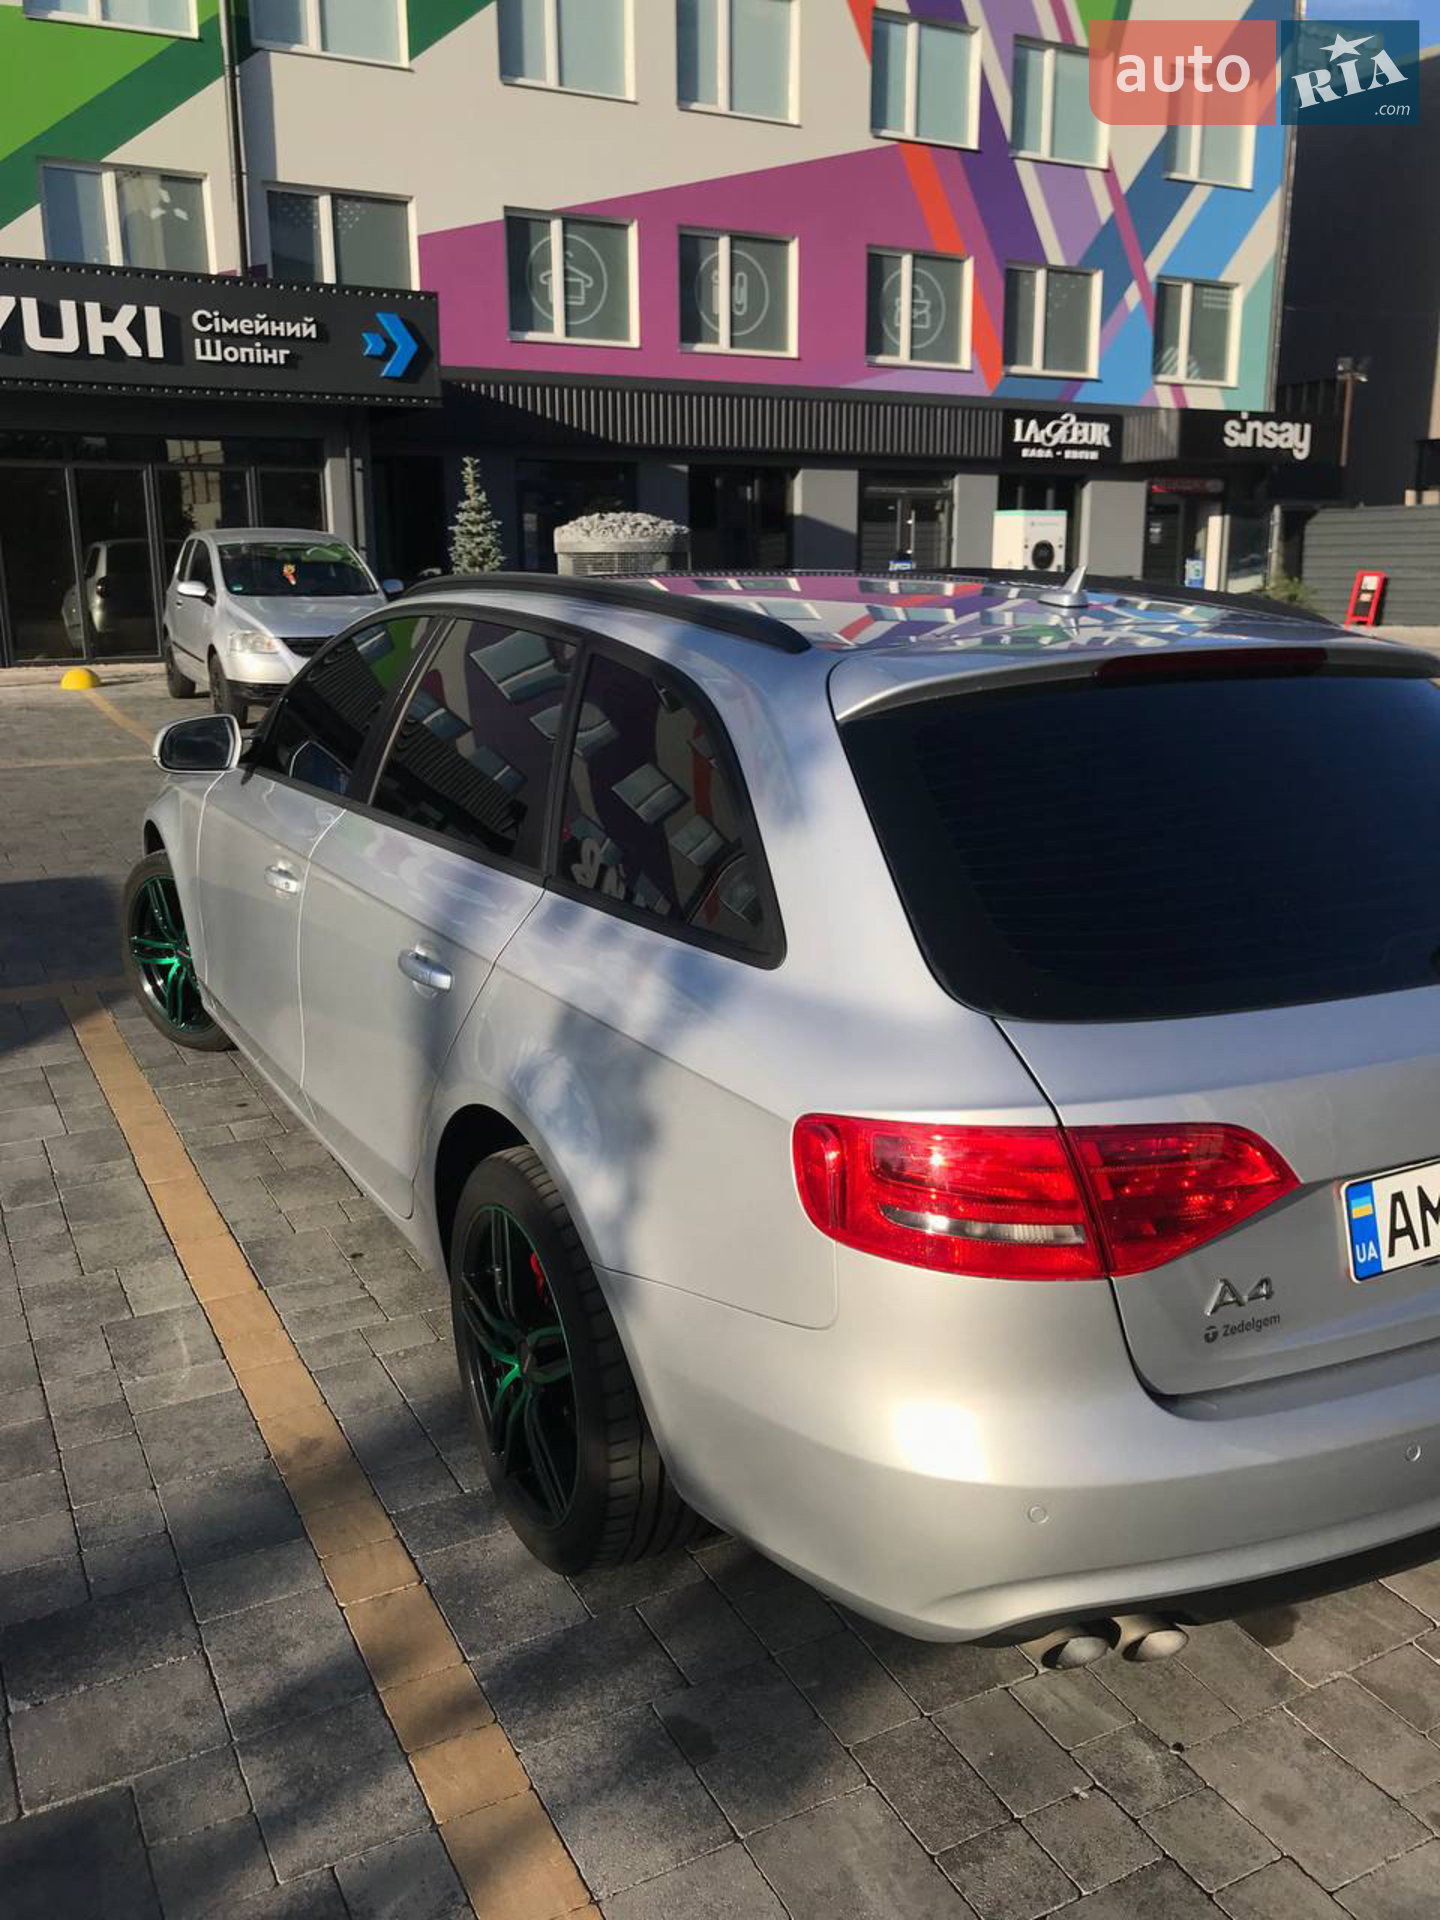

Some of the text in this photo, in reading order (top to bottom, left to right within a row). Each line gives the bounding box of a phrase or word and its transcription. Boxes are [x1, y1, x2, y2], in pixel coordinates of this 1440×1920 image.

[191, 309, 318, 340] Сімейний
[194, 338, 291, 366] Шопінг
[1223, 411, 1311, 460] sinsay
[1355, 1241, 1379, 1264] UA
[1204, 1277, 1276, 1317] A4
[1222, 1314, 1281, 1338] Zedelgem
